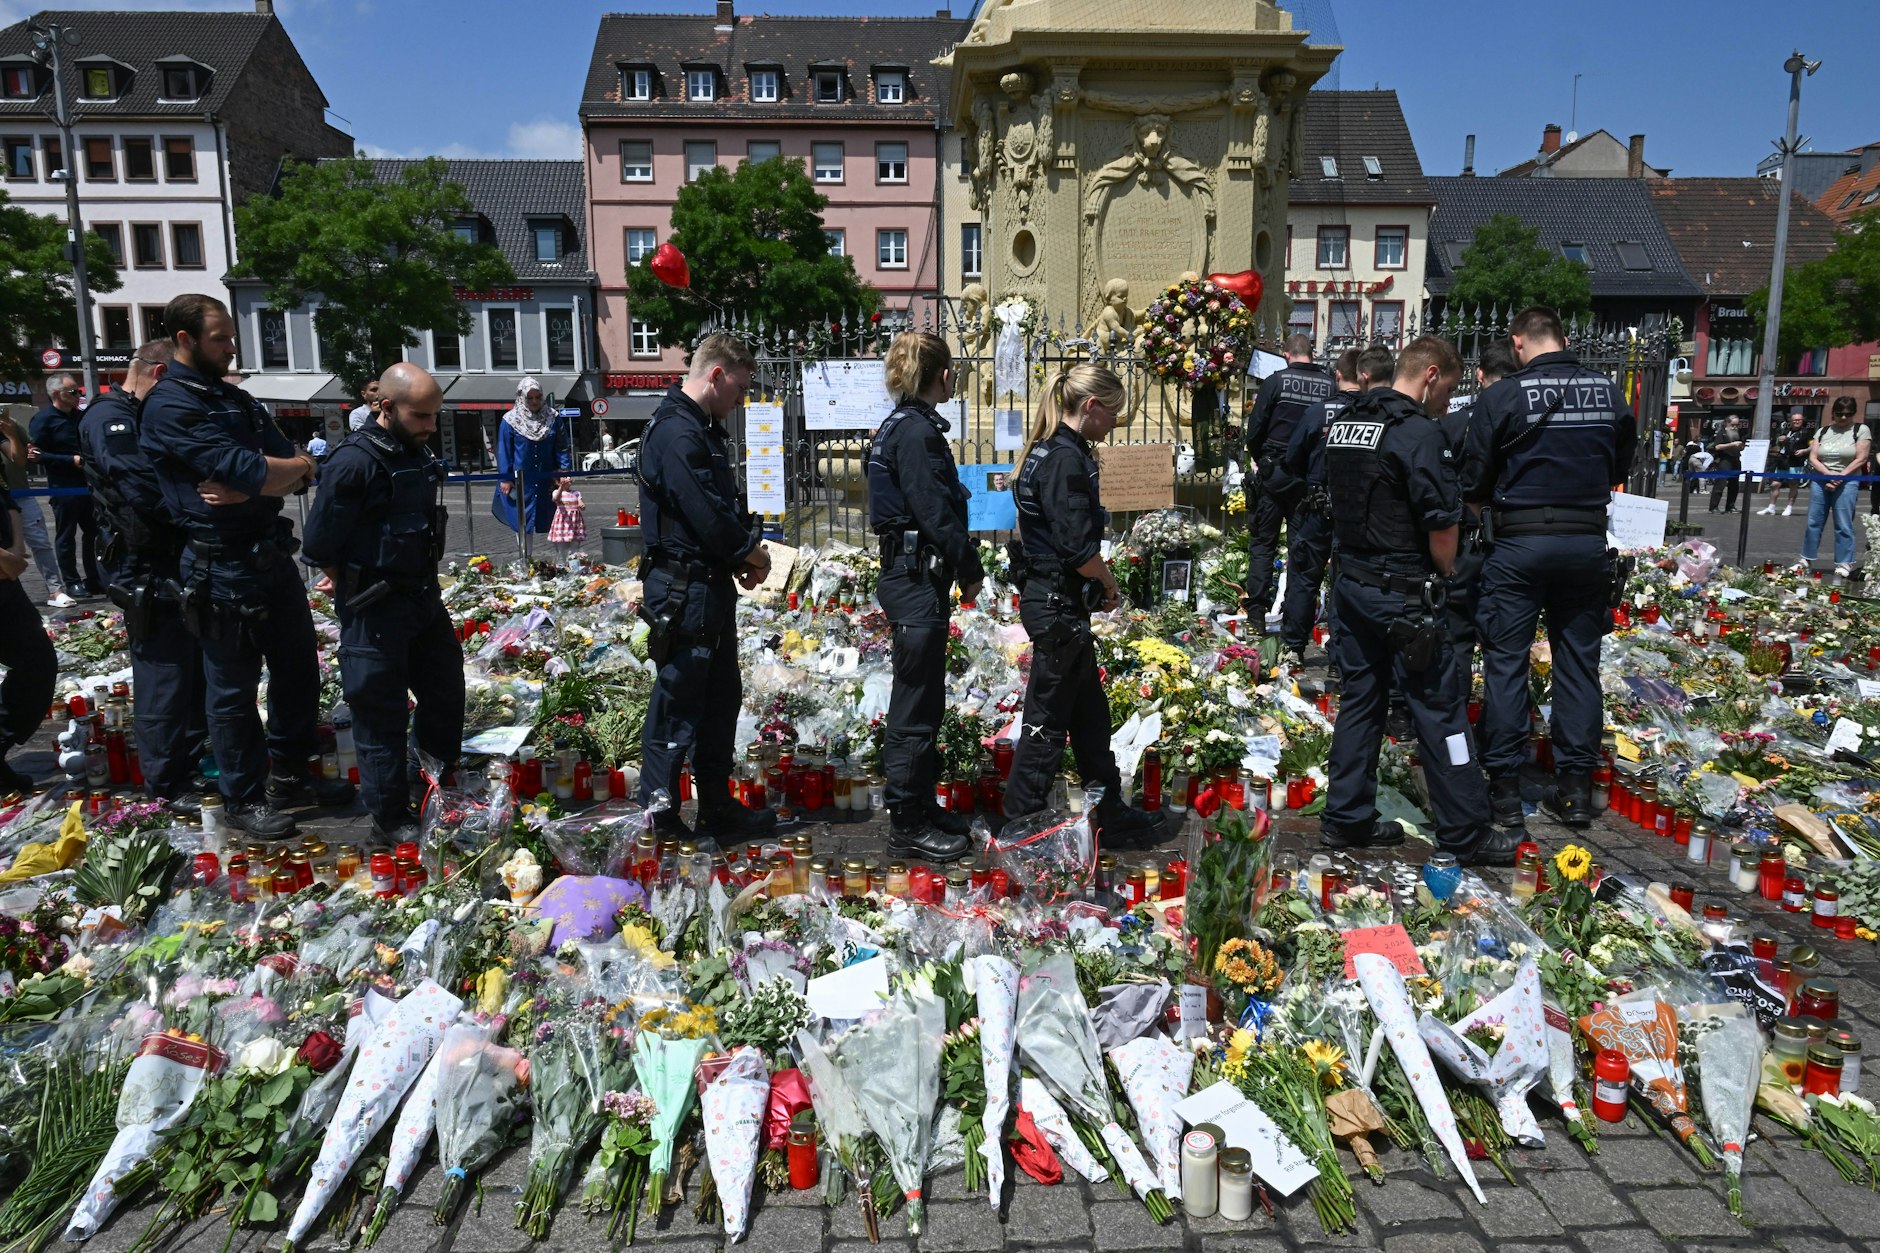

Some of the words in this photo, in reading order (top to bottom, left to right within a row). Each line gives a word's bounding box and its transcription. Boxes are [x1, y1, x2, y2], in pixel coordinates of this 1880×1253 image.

[1288, 280, 1363, 293] KBASI
[1282, 379, 1331, 397] POLIZEI
[1527, 387, 1613, 410] POLIZEI
[1328, 424, 1380, 446] POLIZEI
[1203, 1113, 1221, 1124] Never
[1220, 1100, 1248, 1115] forgotten
